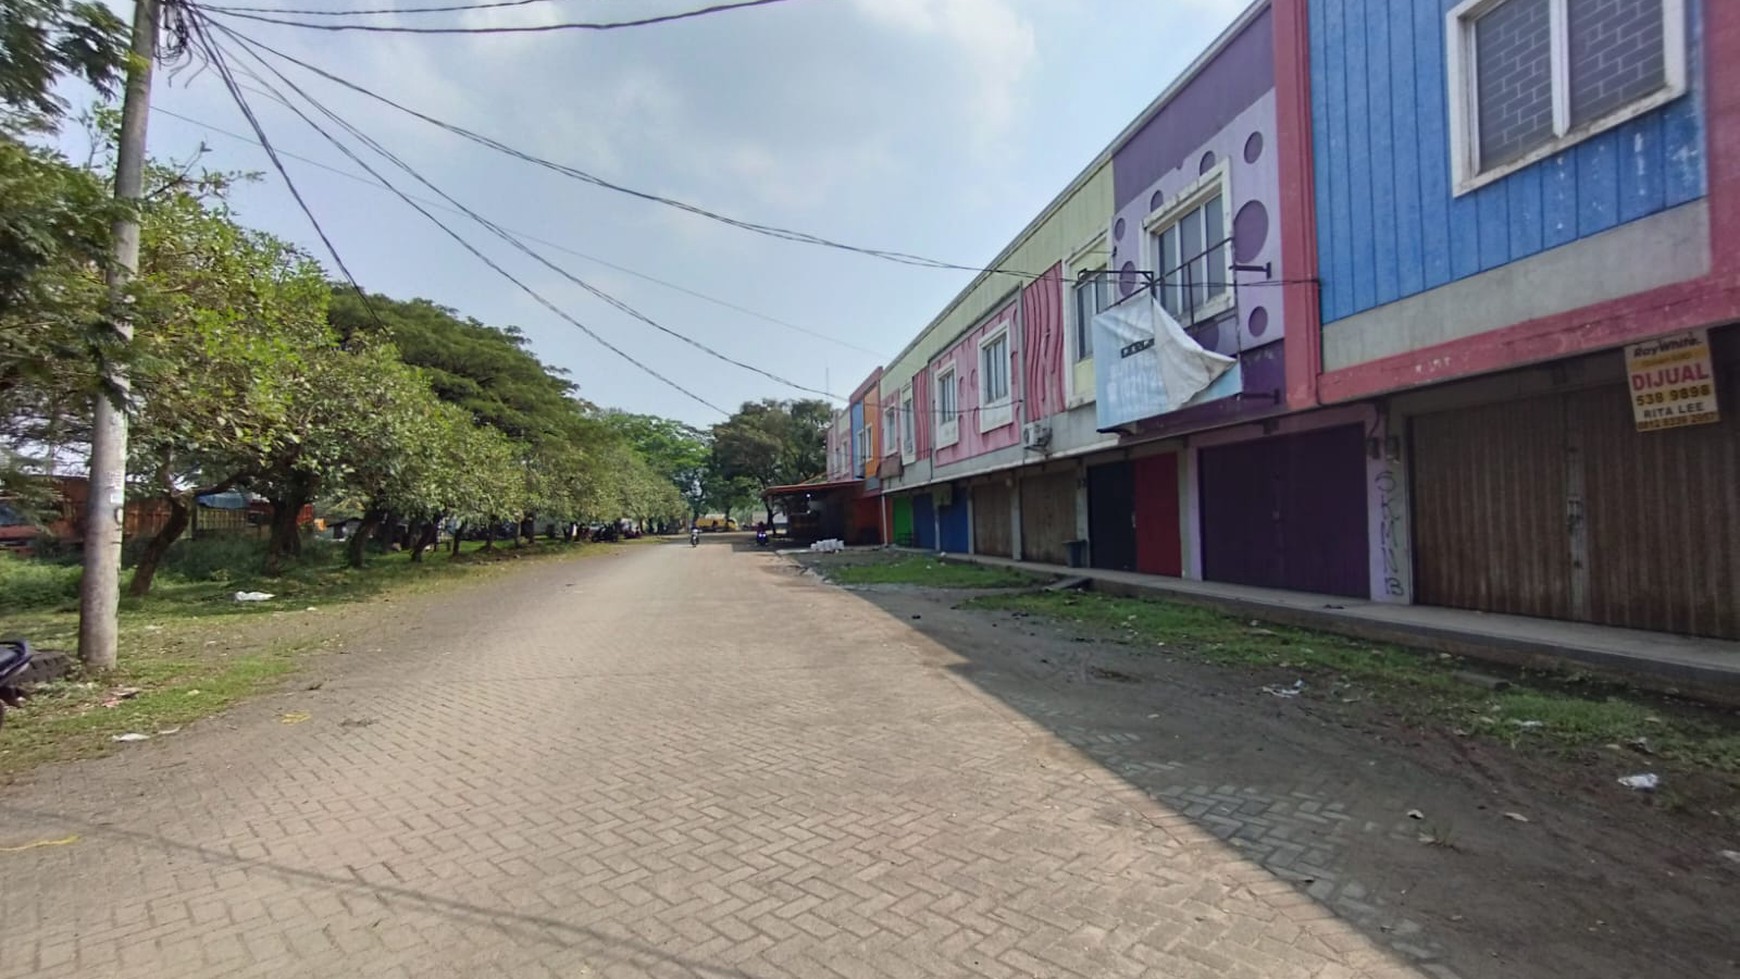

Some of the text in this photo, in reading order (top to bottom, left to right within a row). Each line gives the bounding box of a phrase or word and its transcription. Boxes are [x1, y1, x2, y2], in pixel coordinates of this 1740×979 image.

[1631, 363, 1709, 391] DIJUAL
[1636, 384, 1710, 406] 538 9898
[1643, 402, 1704, 418] RITA LEE
